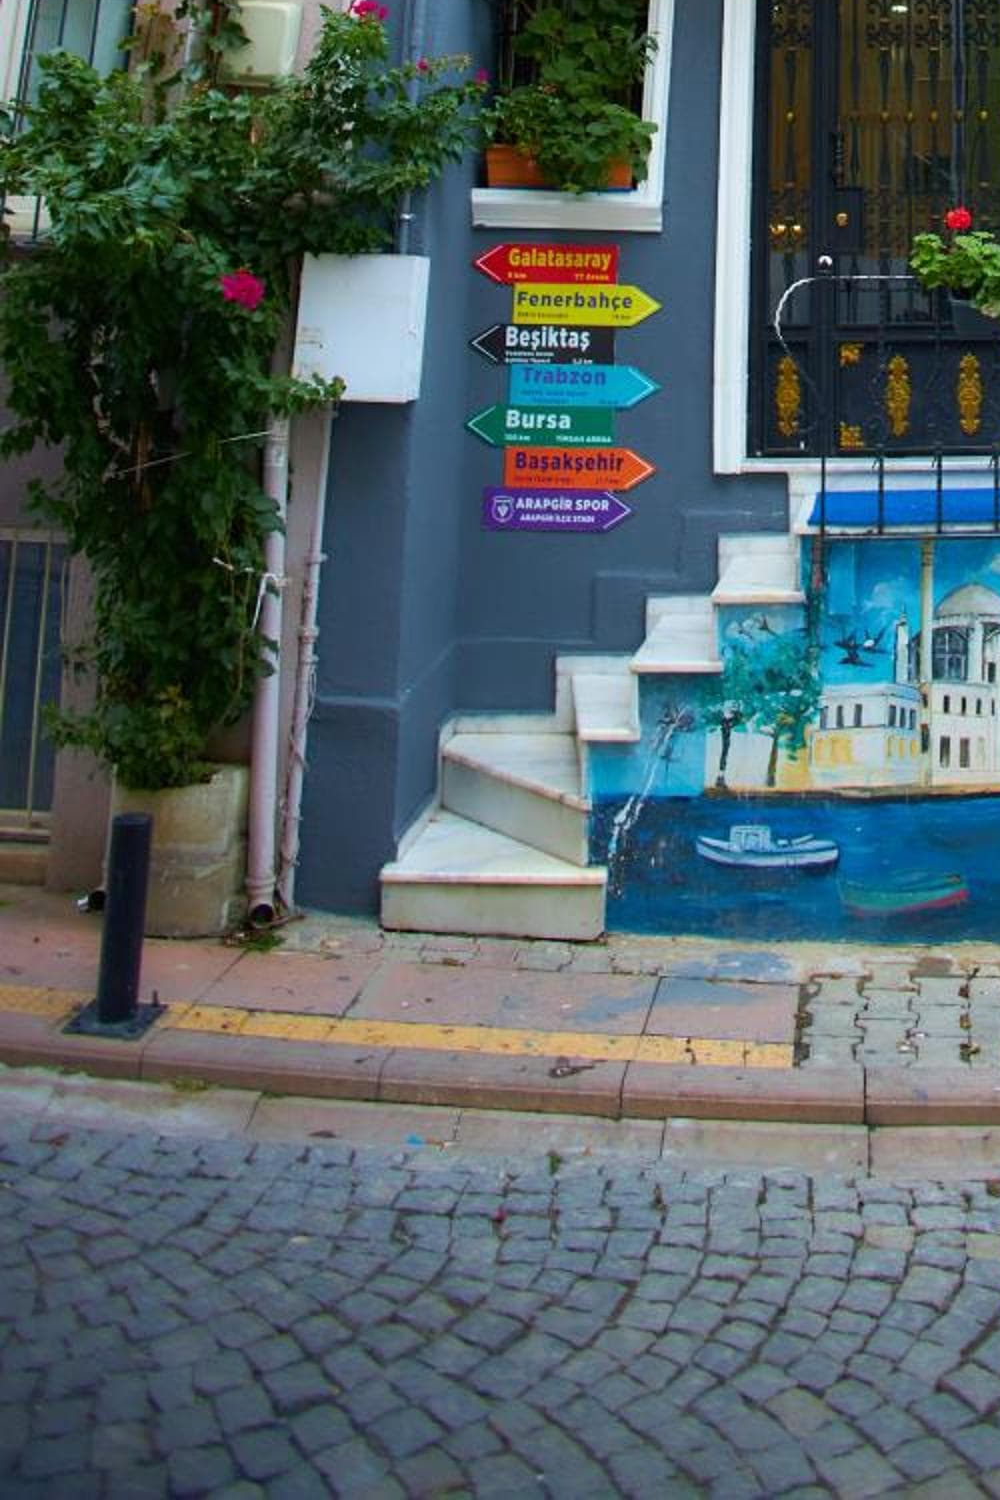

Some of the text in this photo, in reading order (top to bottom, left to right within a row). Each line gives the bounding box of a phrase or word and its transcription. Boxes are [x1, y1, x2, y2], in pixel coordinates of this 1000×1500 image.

[509, 248, 611, 271] Galatasaray
[517, 291, 632, 311] Fenerbahçe
[505, 326, 590, 352] Beşiktaş
[522, 367, 606, 386] Trabzon
[505, 409, 571, 429] Bursa
[515, 452, 624, 474] Başakşehir
[515, 496, 610, 511] ARAPGİR SPOR
